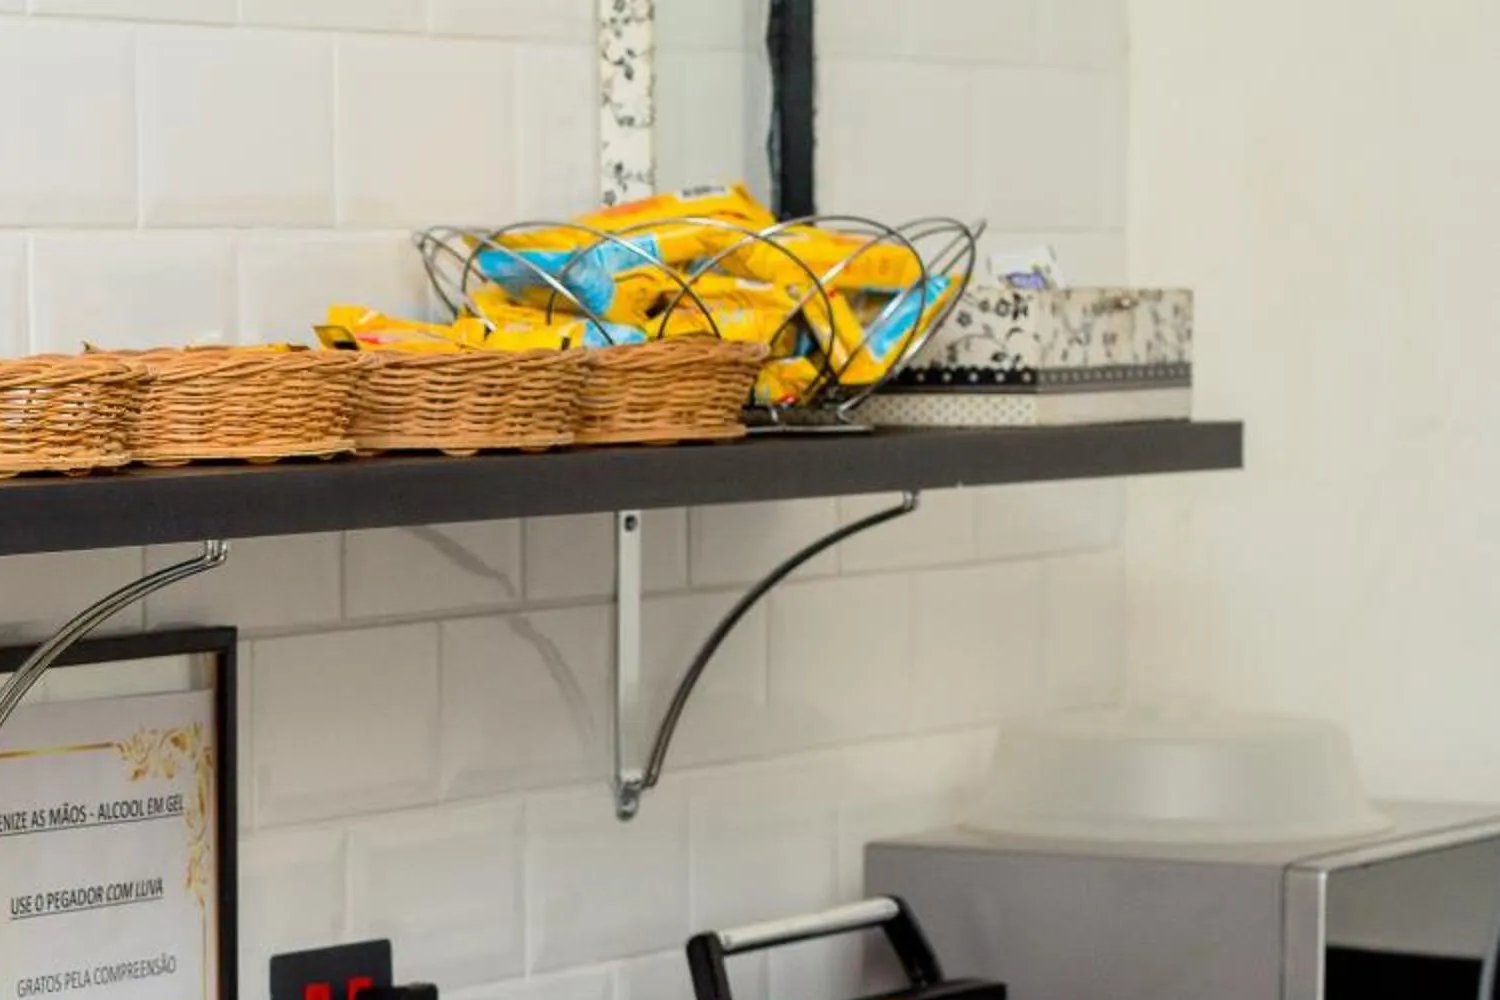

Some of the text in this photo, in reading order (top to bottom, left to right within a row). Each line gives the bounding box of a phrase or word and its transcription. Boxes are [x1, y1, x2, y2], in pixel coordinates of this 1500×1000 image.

[31, 809, 45, 827] AS
[49, 802, 87, 825] MÃOS
[147, 796, 164, 815] EM
[166, 793, 183, 812] GEL
[10, 877, 164, 915] USE O PEGADOR COM LUVA
[17, 952, 177, 998] GRATOS PELA COMPREENSÃO
